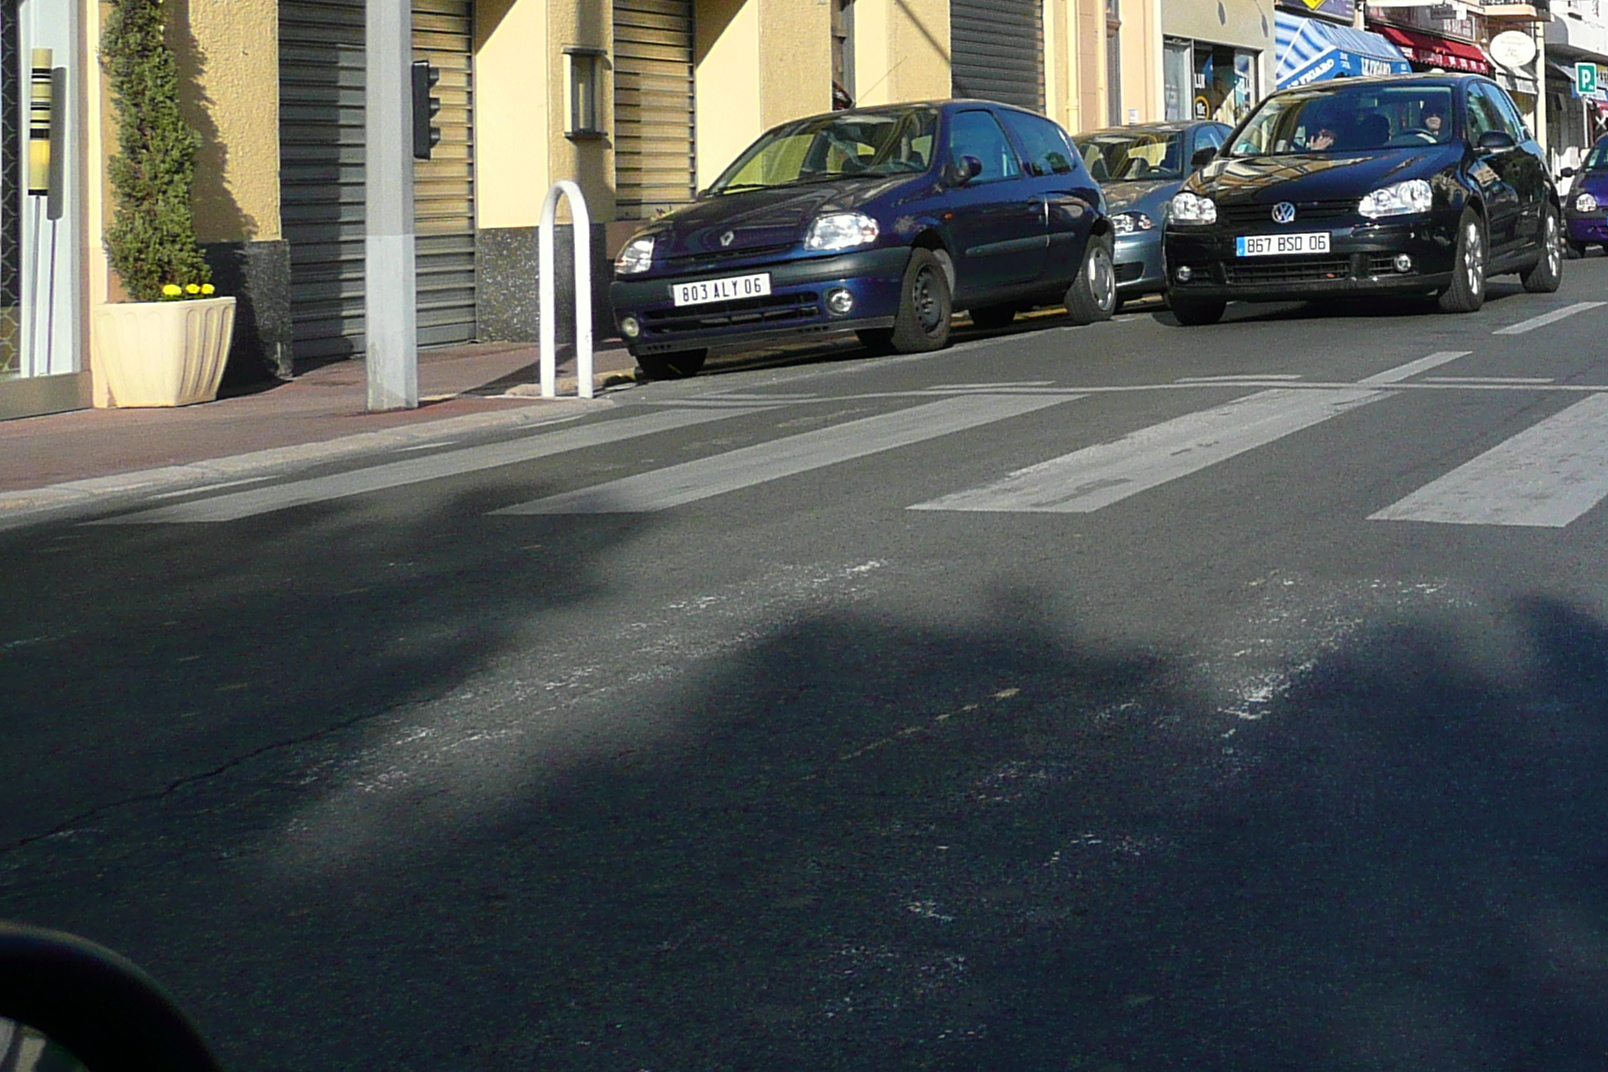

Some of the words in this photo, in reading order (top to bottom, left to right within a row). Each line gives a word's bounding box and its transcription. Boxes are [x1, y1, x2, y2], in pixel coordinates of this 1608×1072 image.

[1581, 68, 1591, 89] P
[1247, 238, 1272, 253] 867
[1309, 235, 1326, 250] 06
[682, 285, 709, 303] 803
[713, 280, 739, 299] ALY
[744, 277, 762, 294] 06
